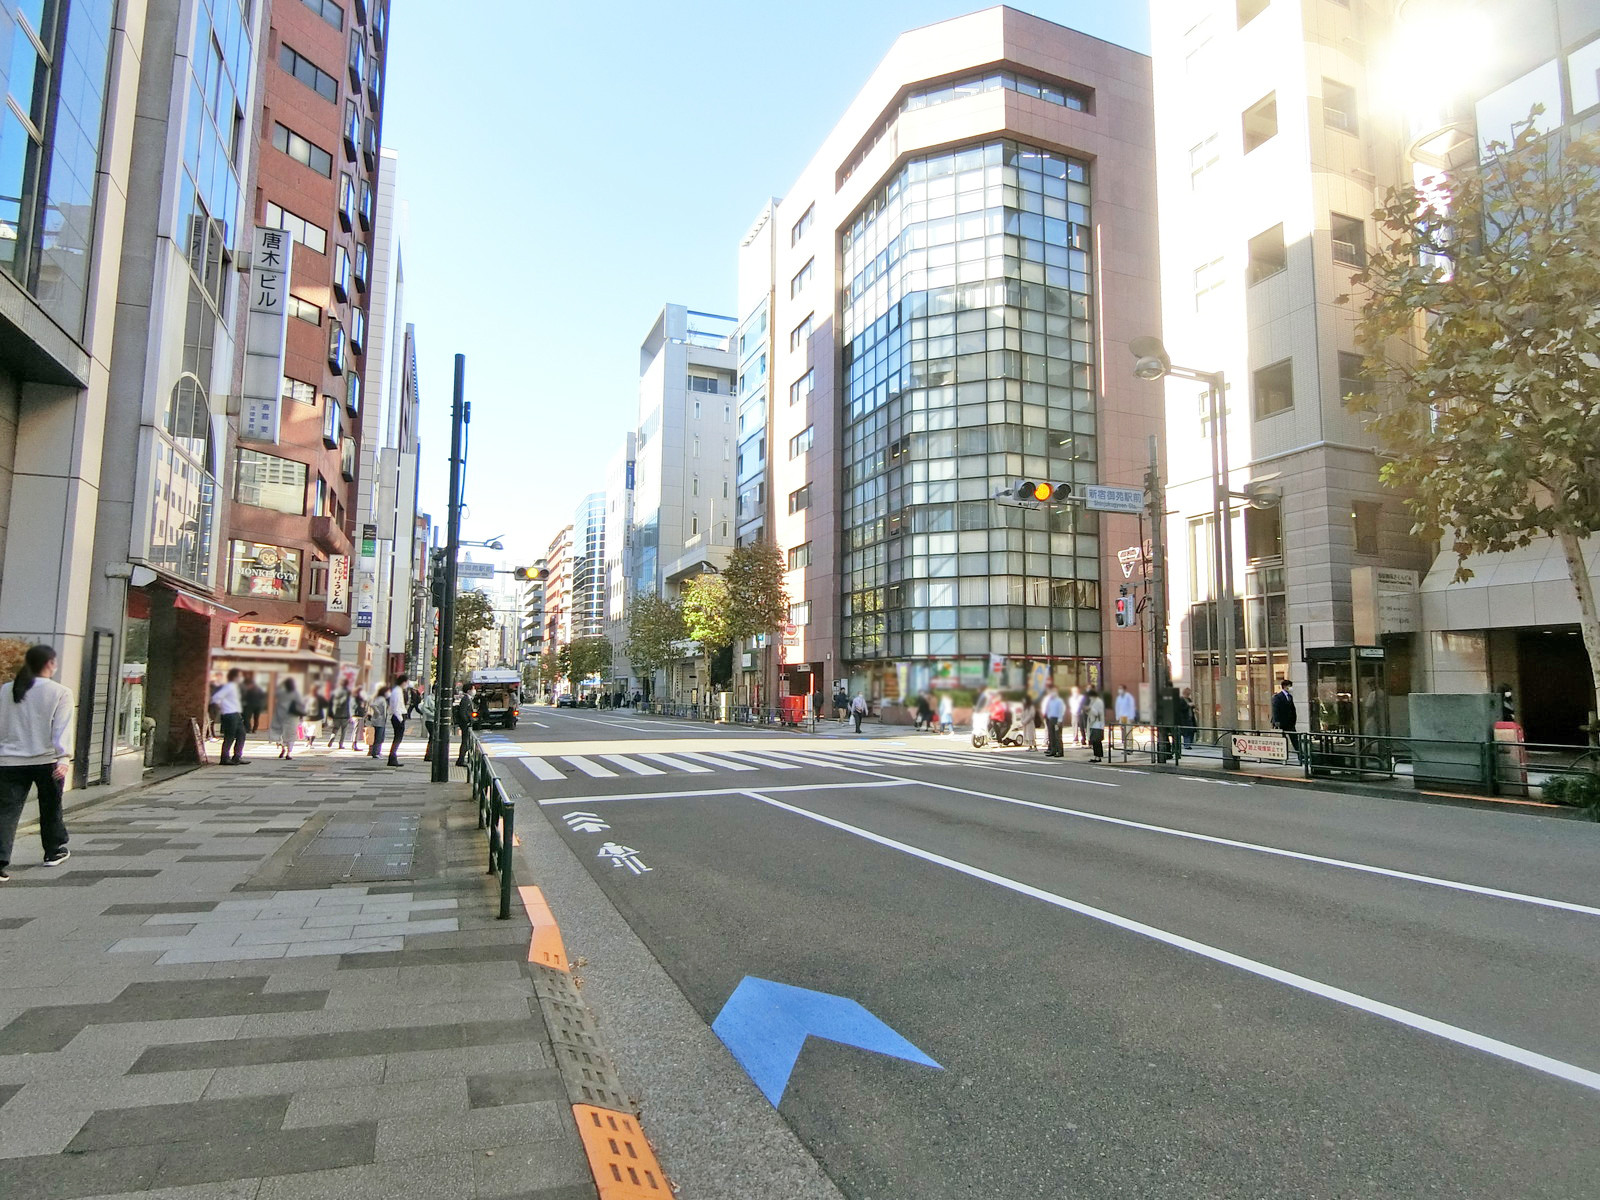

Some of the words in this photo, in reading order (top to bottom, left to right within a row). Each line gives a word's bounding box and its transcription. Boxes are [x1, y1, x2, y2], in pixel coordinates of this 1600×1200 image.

[258, 232, 282, 307] 唐木ビル
[1088, 489, 1142, 503] 新宿御苑駅前
[332, 557, 344, 605] 釜揚げうどん
[238, 634, 289, 648] 丸亀製麺
